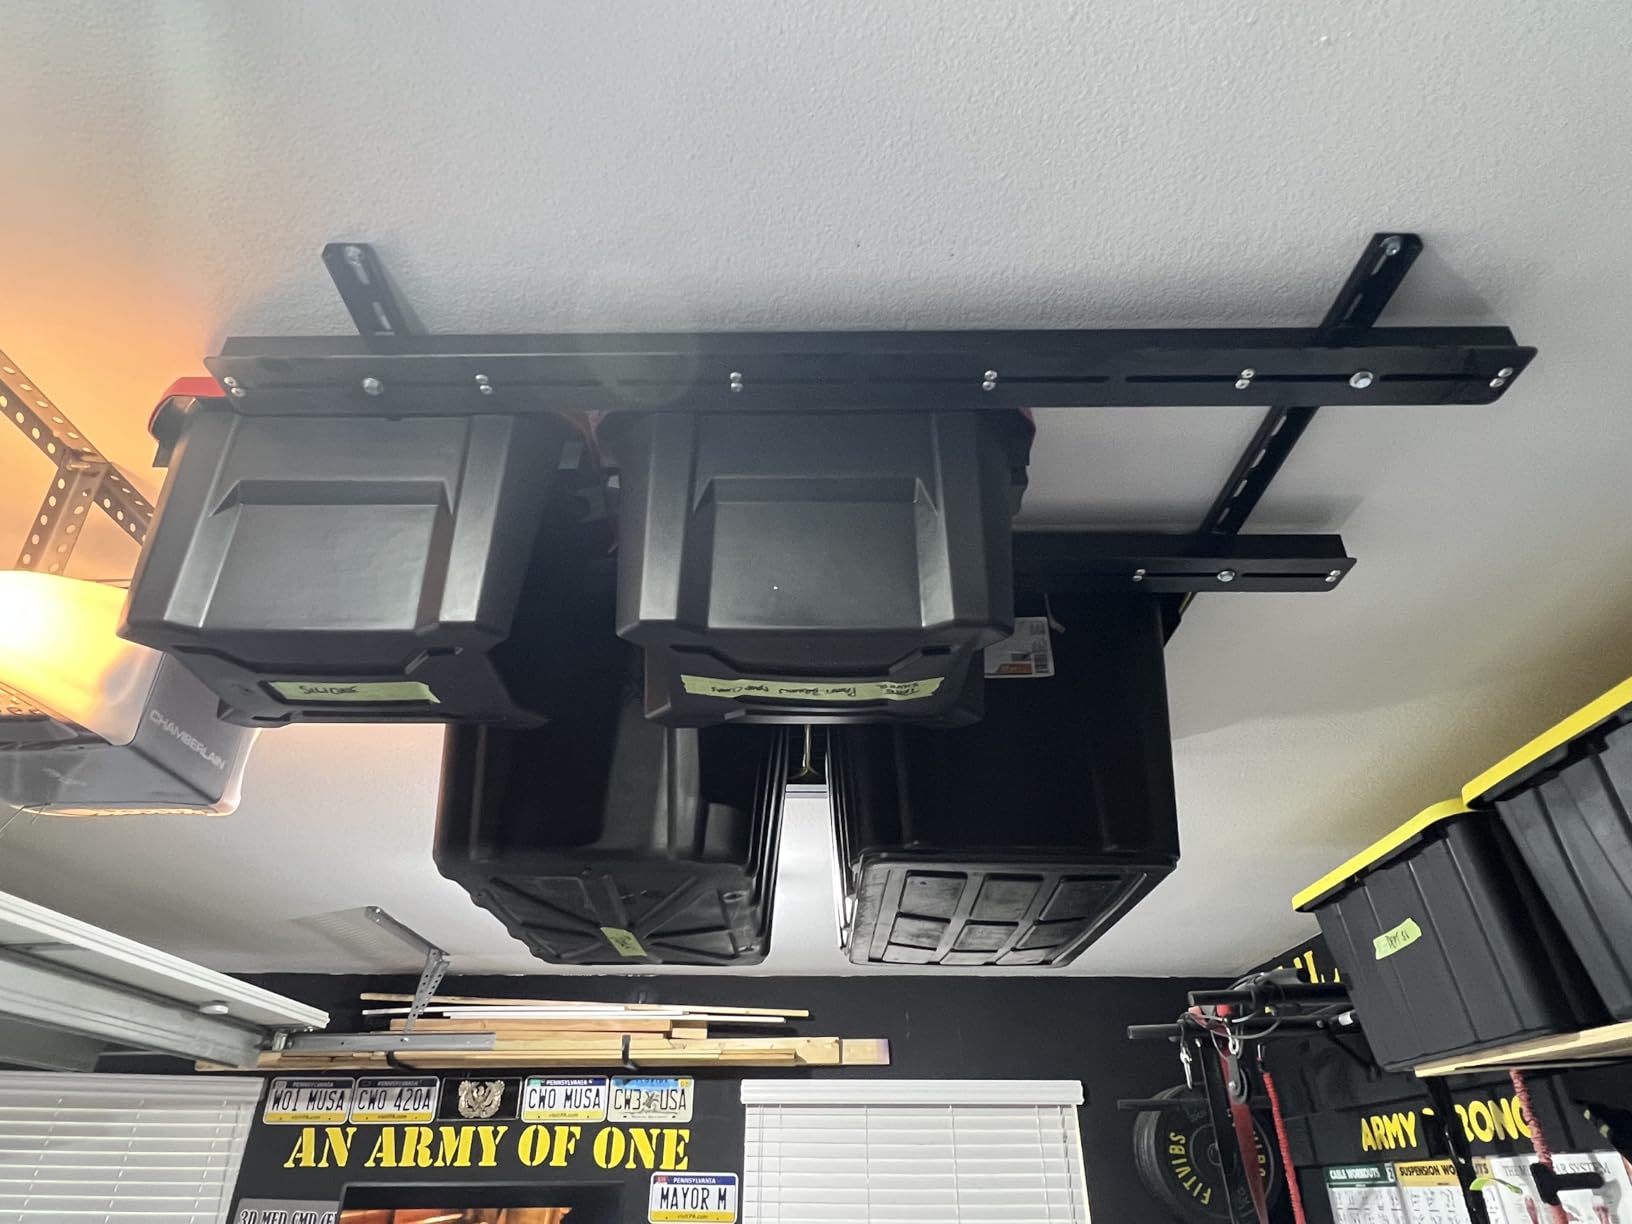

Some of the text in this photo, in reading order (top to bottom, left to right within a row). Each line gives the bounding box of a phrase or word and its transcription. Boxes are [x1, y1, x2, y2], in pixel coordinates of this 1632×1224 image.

[149, 709, 226, 770] CHAMBERLAIN
[545, 1078, 588, 1086] PENNSYLVANIA
[306, 1089, 345, 1112] MUSA
[393, 1088, 430, 1112] 420A
[563, 1087, 601, 1110] MUSA
[614, 1088, 687, 1110] CW3 USA
[1361, 1111, 1418, 1152] ARMY
[283, 1124, 691, 1170] AN ARMY OF ONE
[1168, 1132, 1212, 1205] FITVIBS
[1346, 1167, 1381, 1180] WORKOUTS
[1399, 1165, 1440, 1177] SUSPENSION
[660, 1186, 728, 1211] MAYOR M
